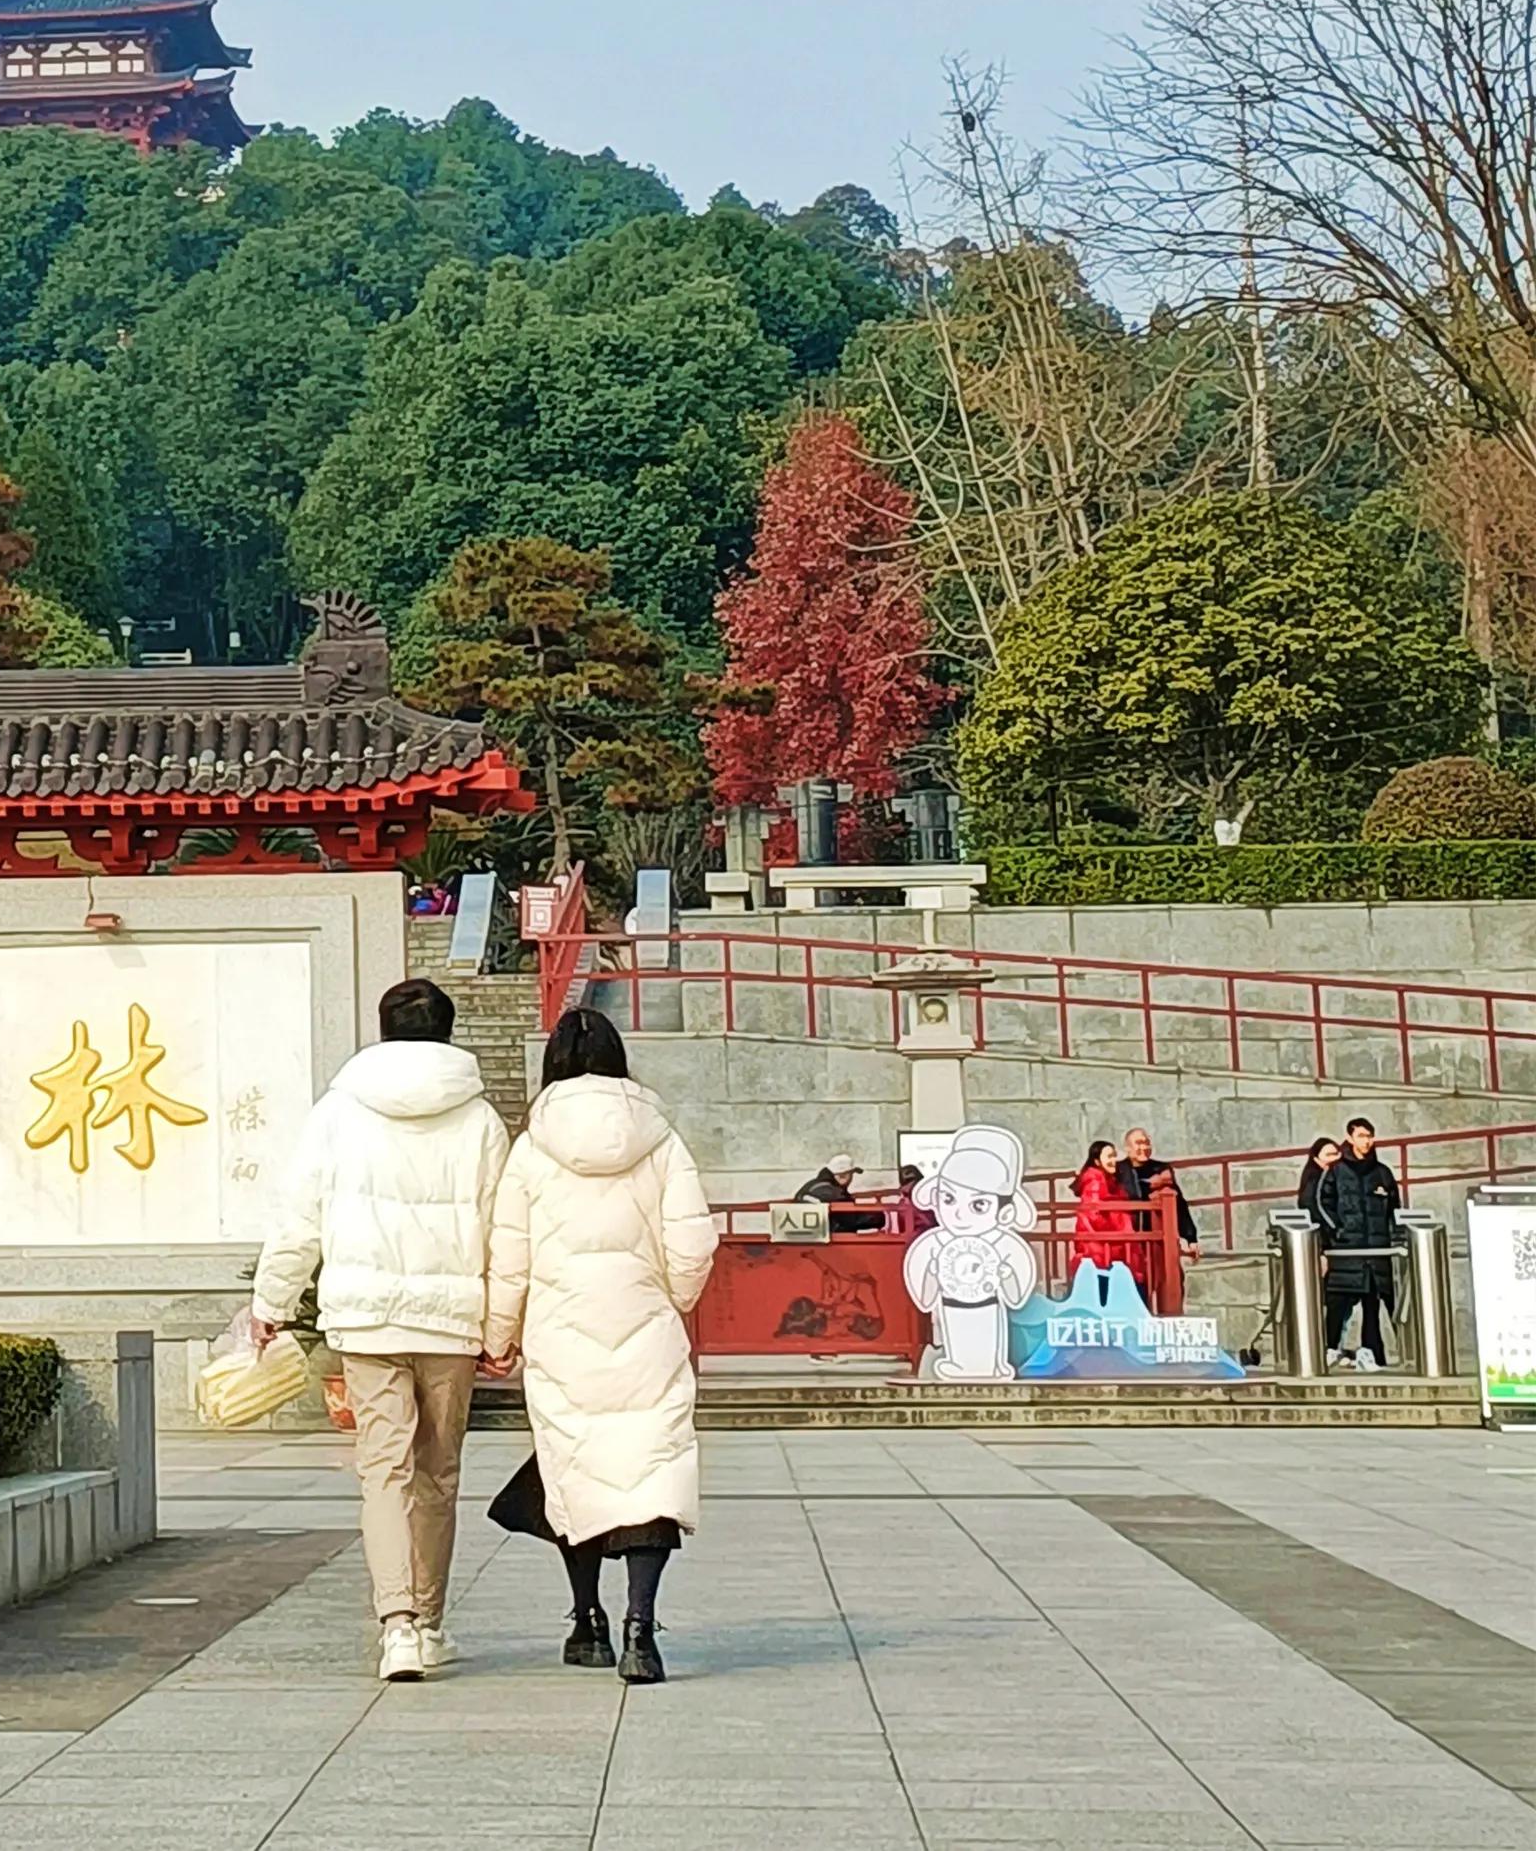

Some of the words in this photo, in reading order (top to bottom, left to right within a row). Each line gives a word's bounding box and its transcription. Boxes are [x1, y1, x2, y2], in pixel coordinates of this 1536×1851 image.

[779, 1211, 820, 1229] 入口
[1047, 1317, 1128, 1347] 吃住行
